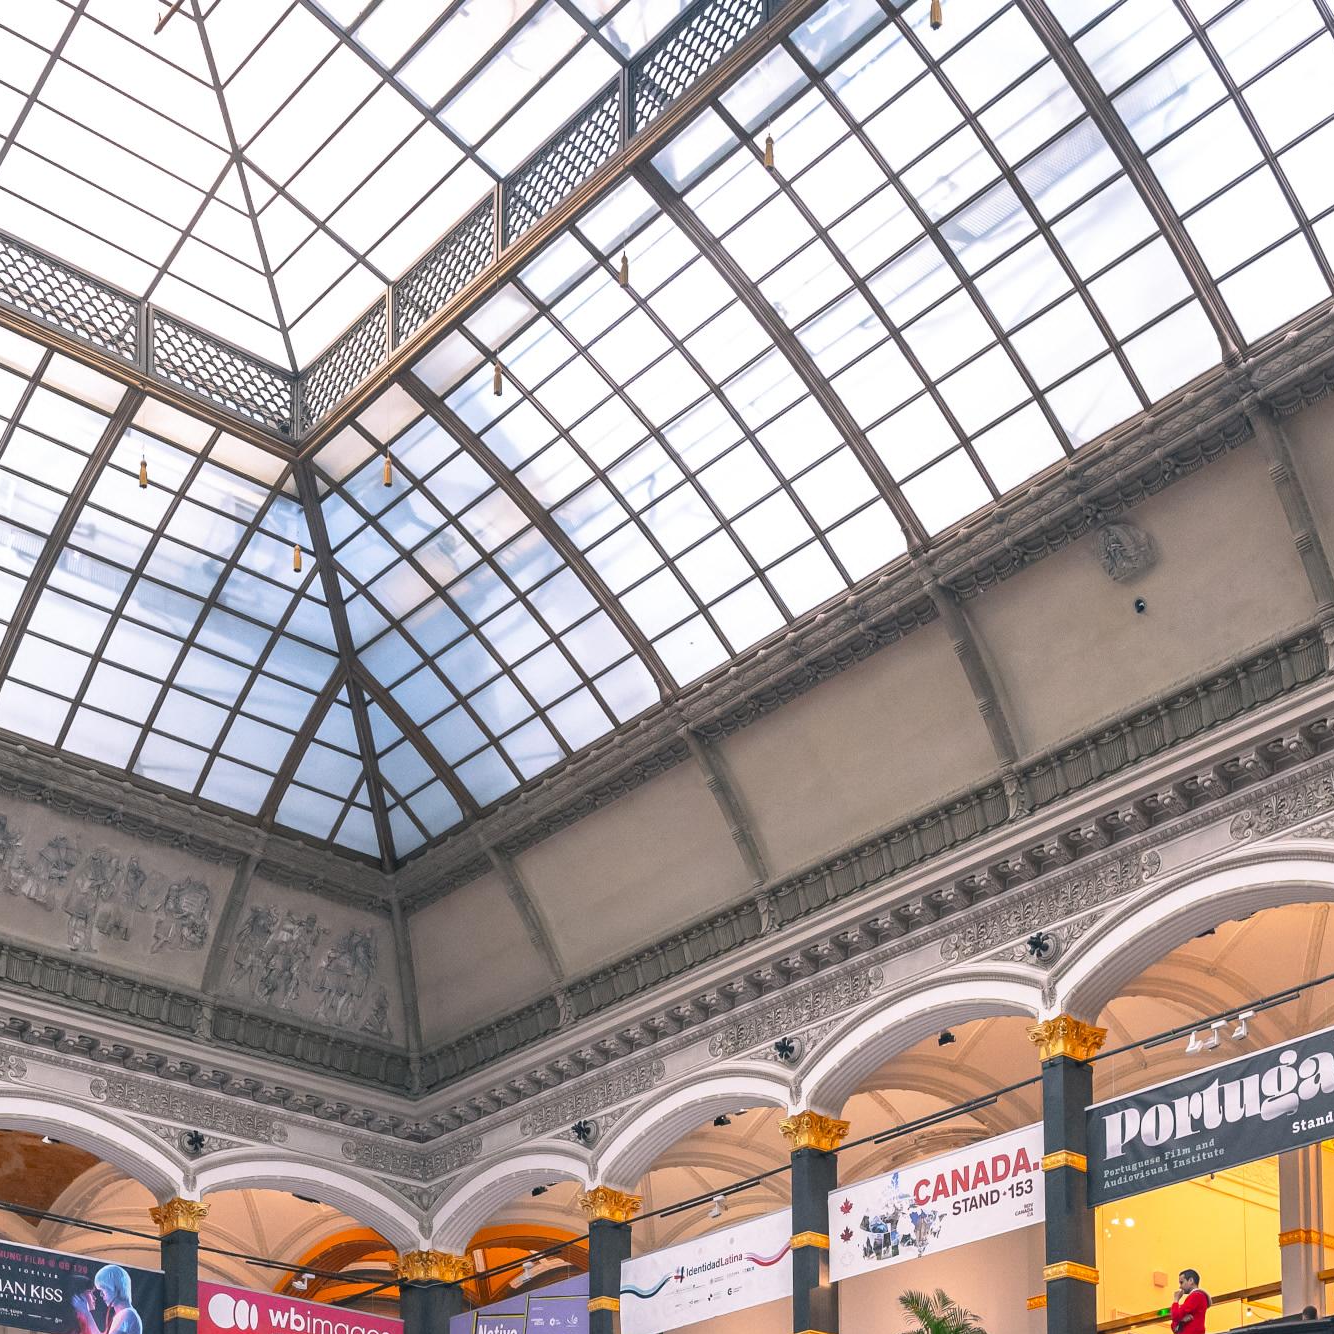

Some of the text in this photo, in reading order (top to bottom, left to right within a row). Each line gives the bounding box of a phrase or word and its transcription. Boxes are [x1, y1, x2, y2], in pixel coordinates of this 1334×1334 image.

[1292, 1111, 1334, 1134] Stand
[1103, 1138, 1215, 1178] Portuguese Film and
[1103, 1147, 1225, 1190] Audiovisual Institute
[952, 1178, 1034, 1216] STAND 153
[25, 1255, 46, 1266] FILM
[18, 1267, 60, 1279] FOREVER
[13, 1296, 43, 1305] BREATH
[30, 1284, 63, 1303] KISS
